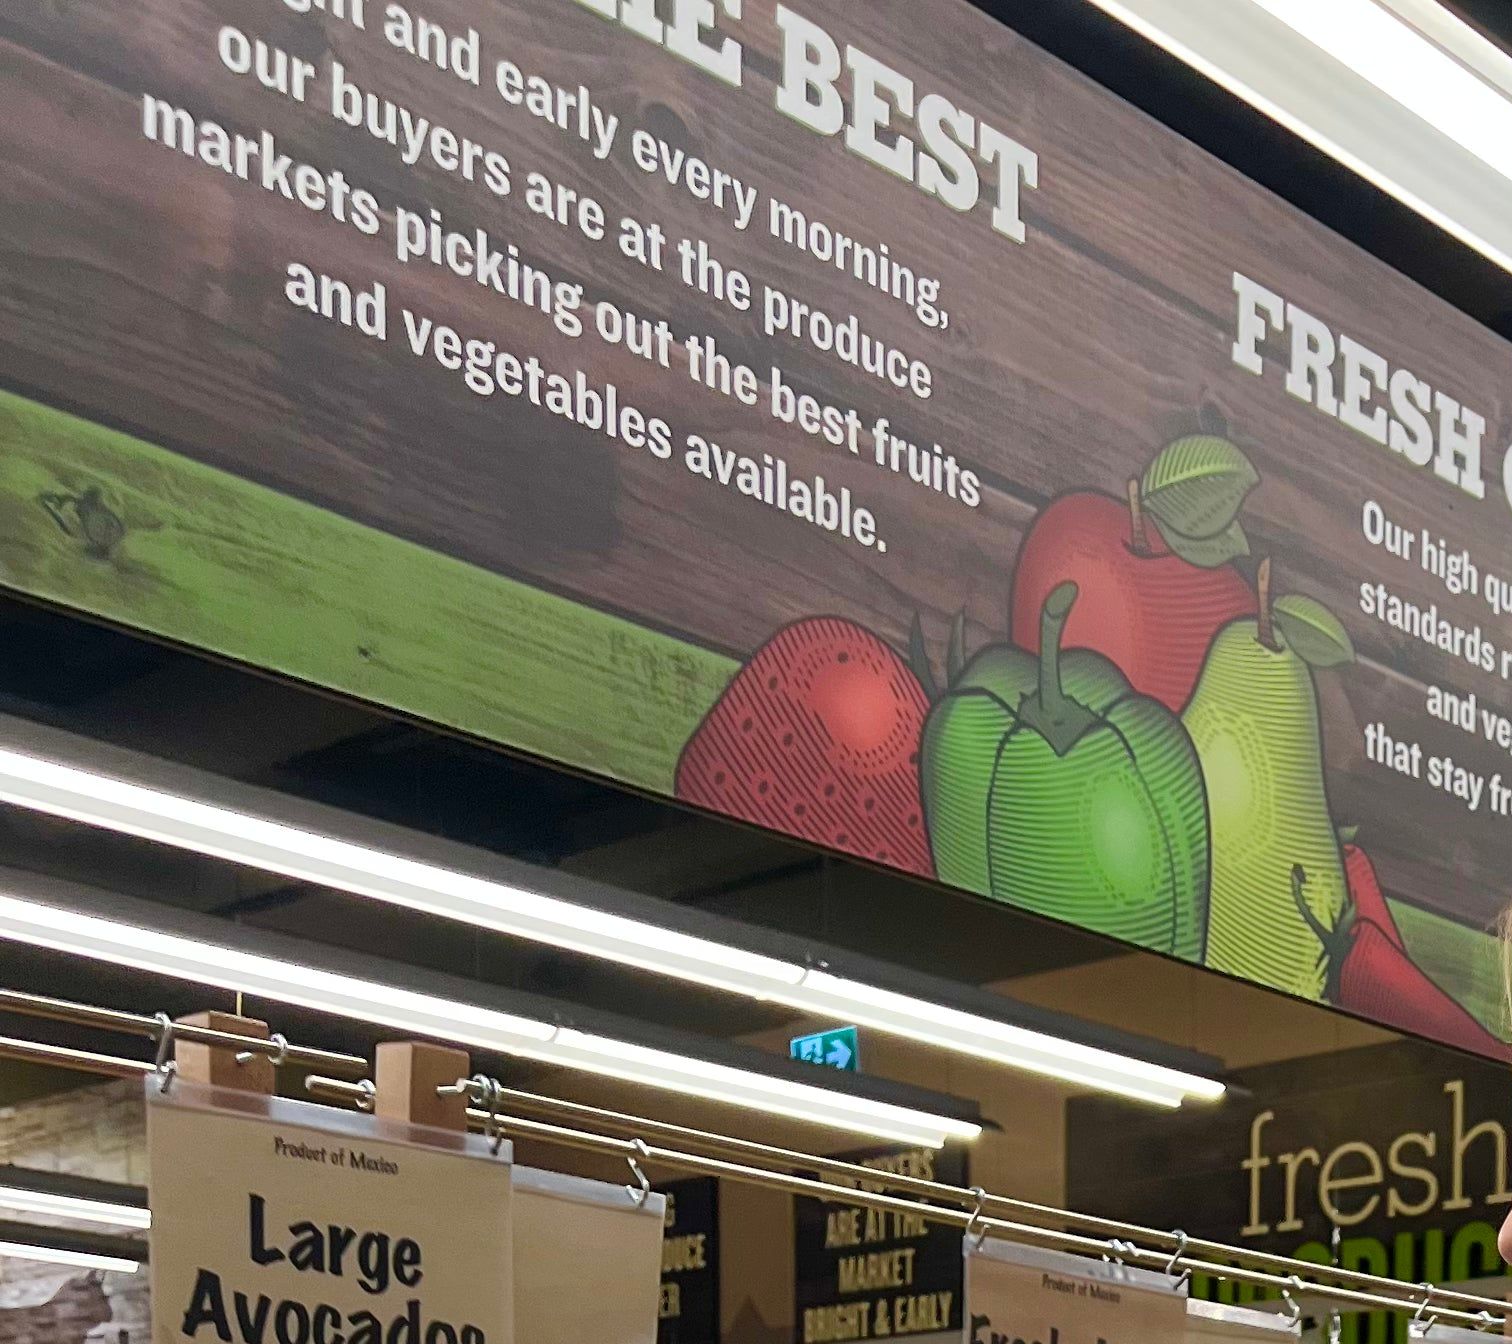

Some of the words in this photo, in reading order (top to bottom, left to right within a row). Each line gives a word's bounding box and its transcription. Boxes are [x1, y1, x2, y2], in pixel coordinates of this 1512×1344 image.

[384, 4, 479, 85] and
[496, 59, 618, 159] early
[632, 127, 756, 229] every
[769, 197, 949, 330] morning,
[775, 4, 1039, 244] BEST
[218, 26, 315, 100] our
[331, 61, 510, 195] buyers
[526, 174, 605, 241] are
[619, 217, 665, 271] at
[678, 238, 752, 311] the
[763, 286, 933, 399] produce
[142, 95, 380, 236] markets
[396, 204, 583, 339] picking
[595, 299, 674, 368] out
[686, 334, 758, 407] the
[770, 367, 862, 457] best
[870, 416, 981, 508] fruits
[285, 261, 388, 341] and
[401, 308, 672, 461] vegetables
[684, 432, 888, 554] available.
[1232, 272, 1485, 499] FRESH
[1362, 501, 1415, 560] Our
[1421, 529, 1478, 595] high
[1359, 582, 1496, 673] standards
[1426, 685, 1476, 733] and
[1364, 723, 1422, 778] that
[1427, 756, 1484, 811] stay
[274, 1136, 326, 1163] Product
[331, 1148, 345, 1166] of
[350, 1151, 398, 1175] Mexico
[249, 1192, 423, 1294] Large
[838, 1248, 915, 1293] MARKET
[804, 1301, 870, 1344] BRIGHT
[894, 1291, 953, 1333] EARLY
